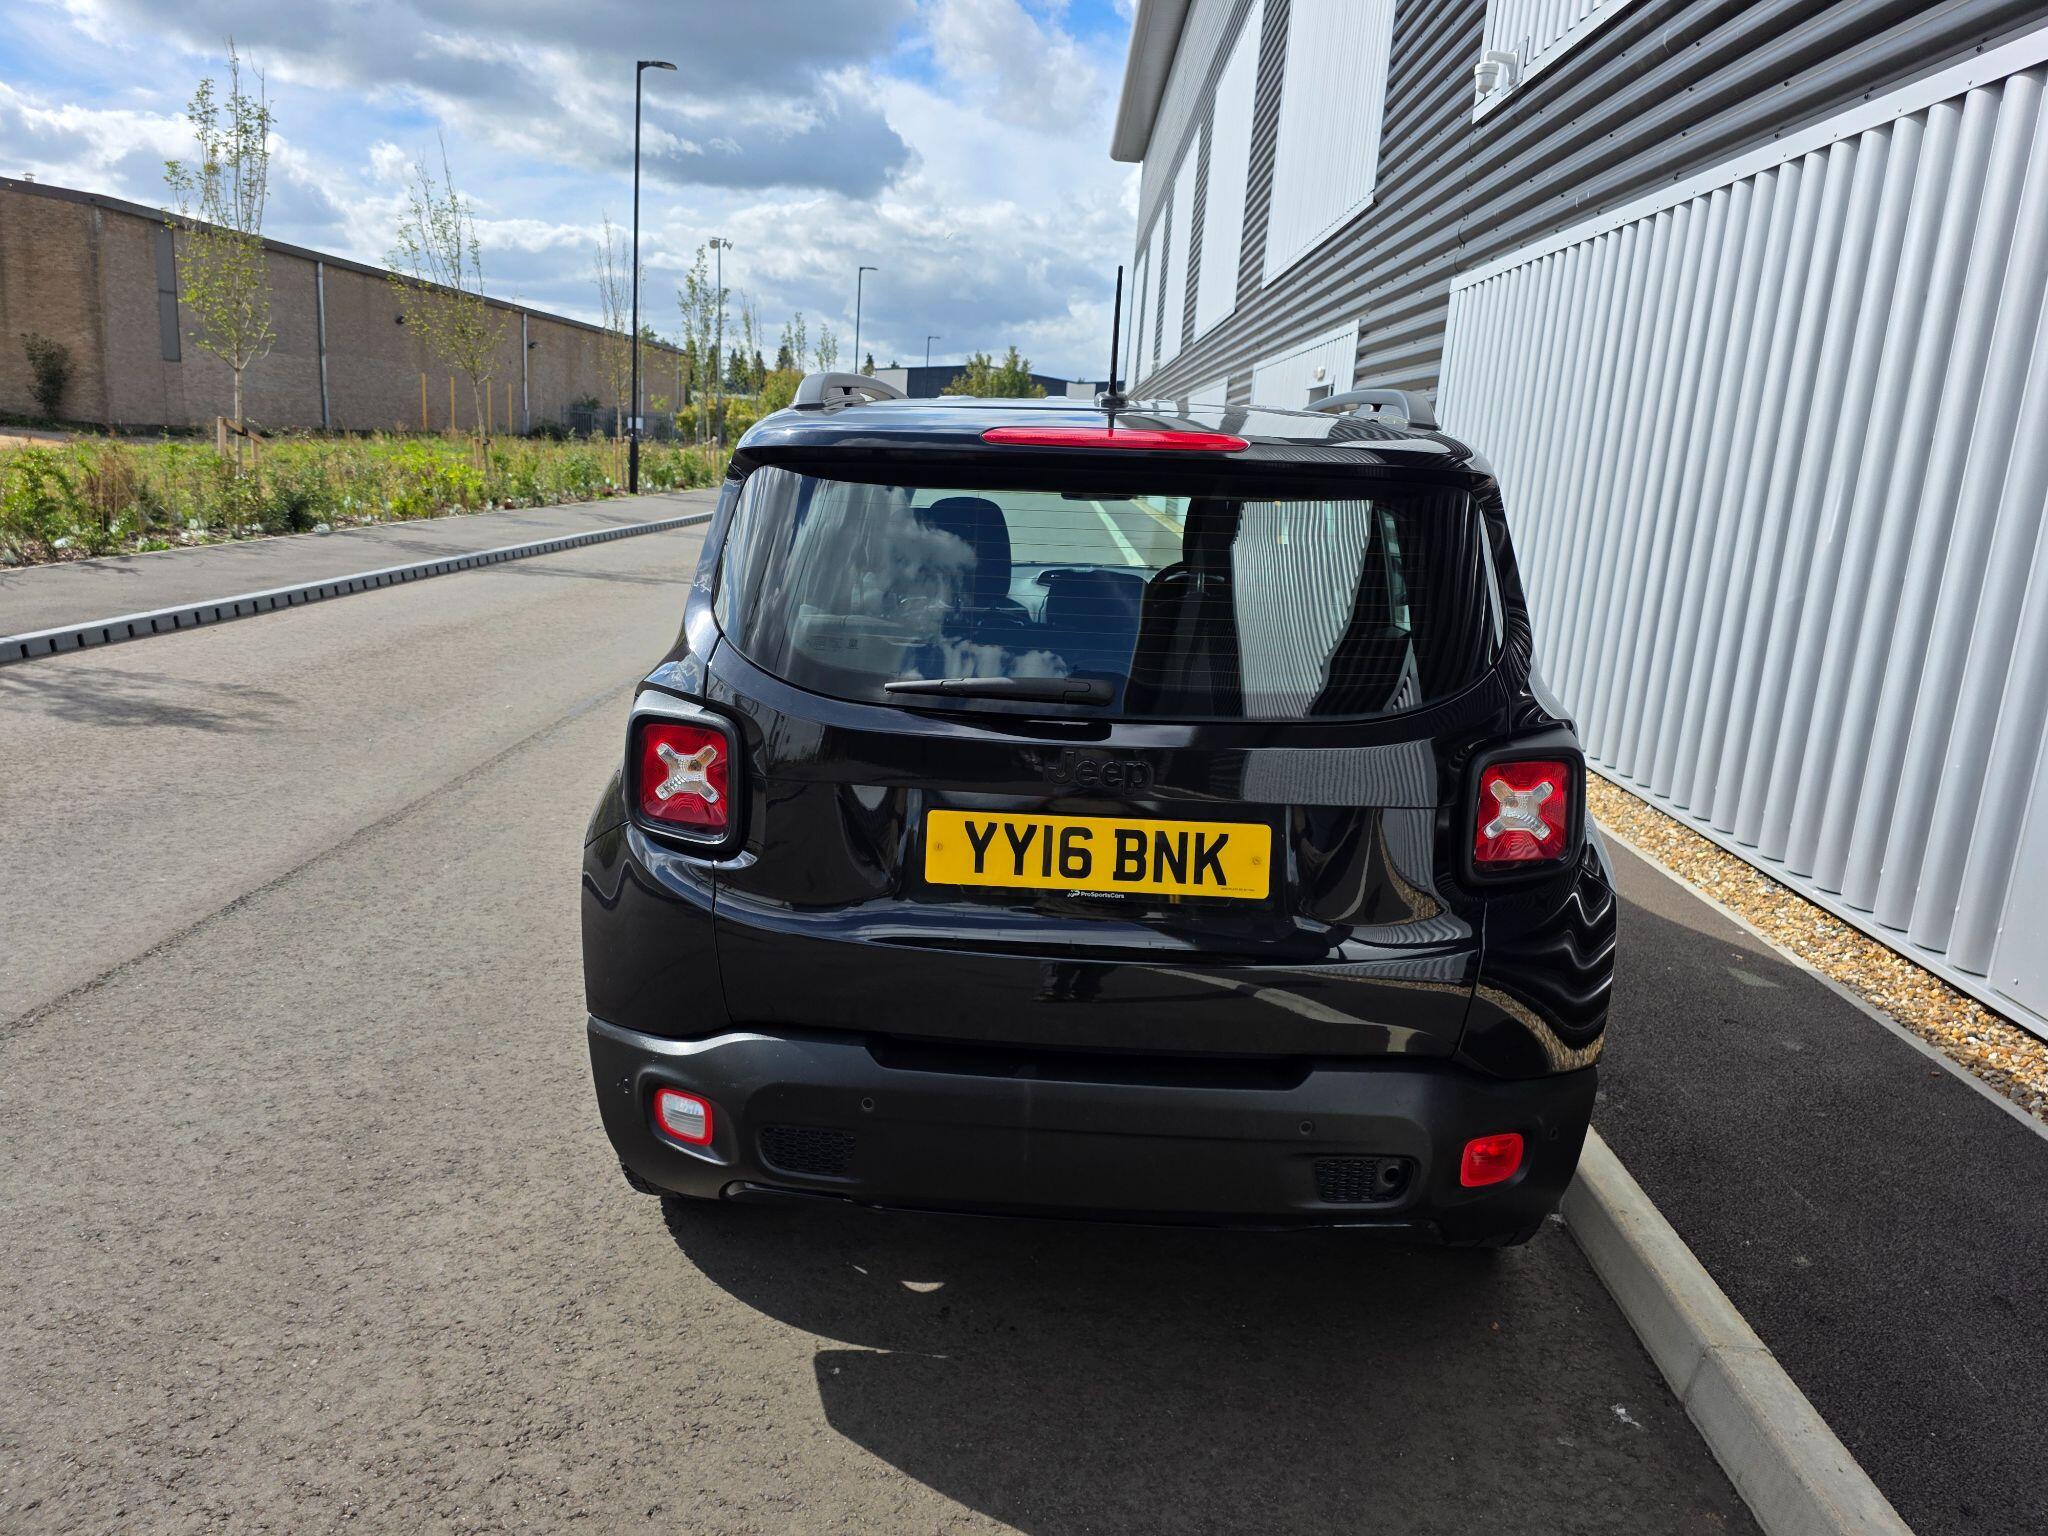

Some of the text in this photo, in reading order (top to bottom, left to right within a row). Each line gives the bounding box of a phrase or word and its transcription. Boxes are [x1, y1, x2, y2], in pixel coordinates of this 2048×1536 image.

[1046, 751, 1153, 795] Jeep
[964, 820, 1229, 886] YY16 BNK
[1080, 891, 1125, 899] ProSportsCars
